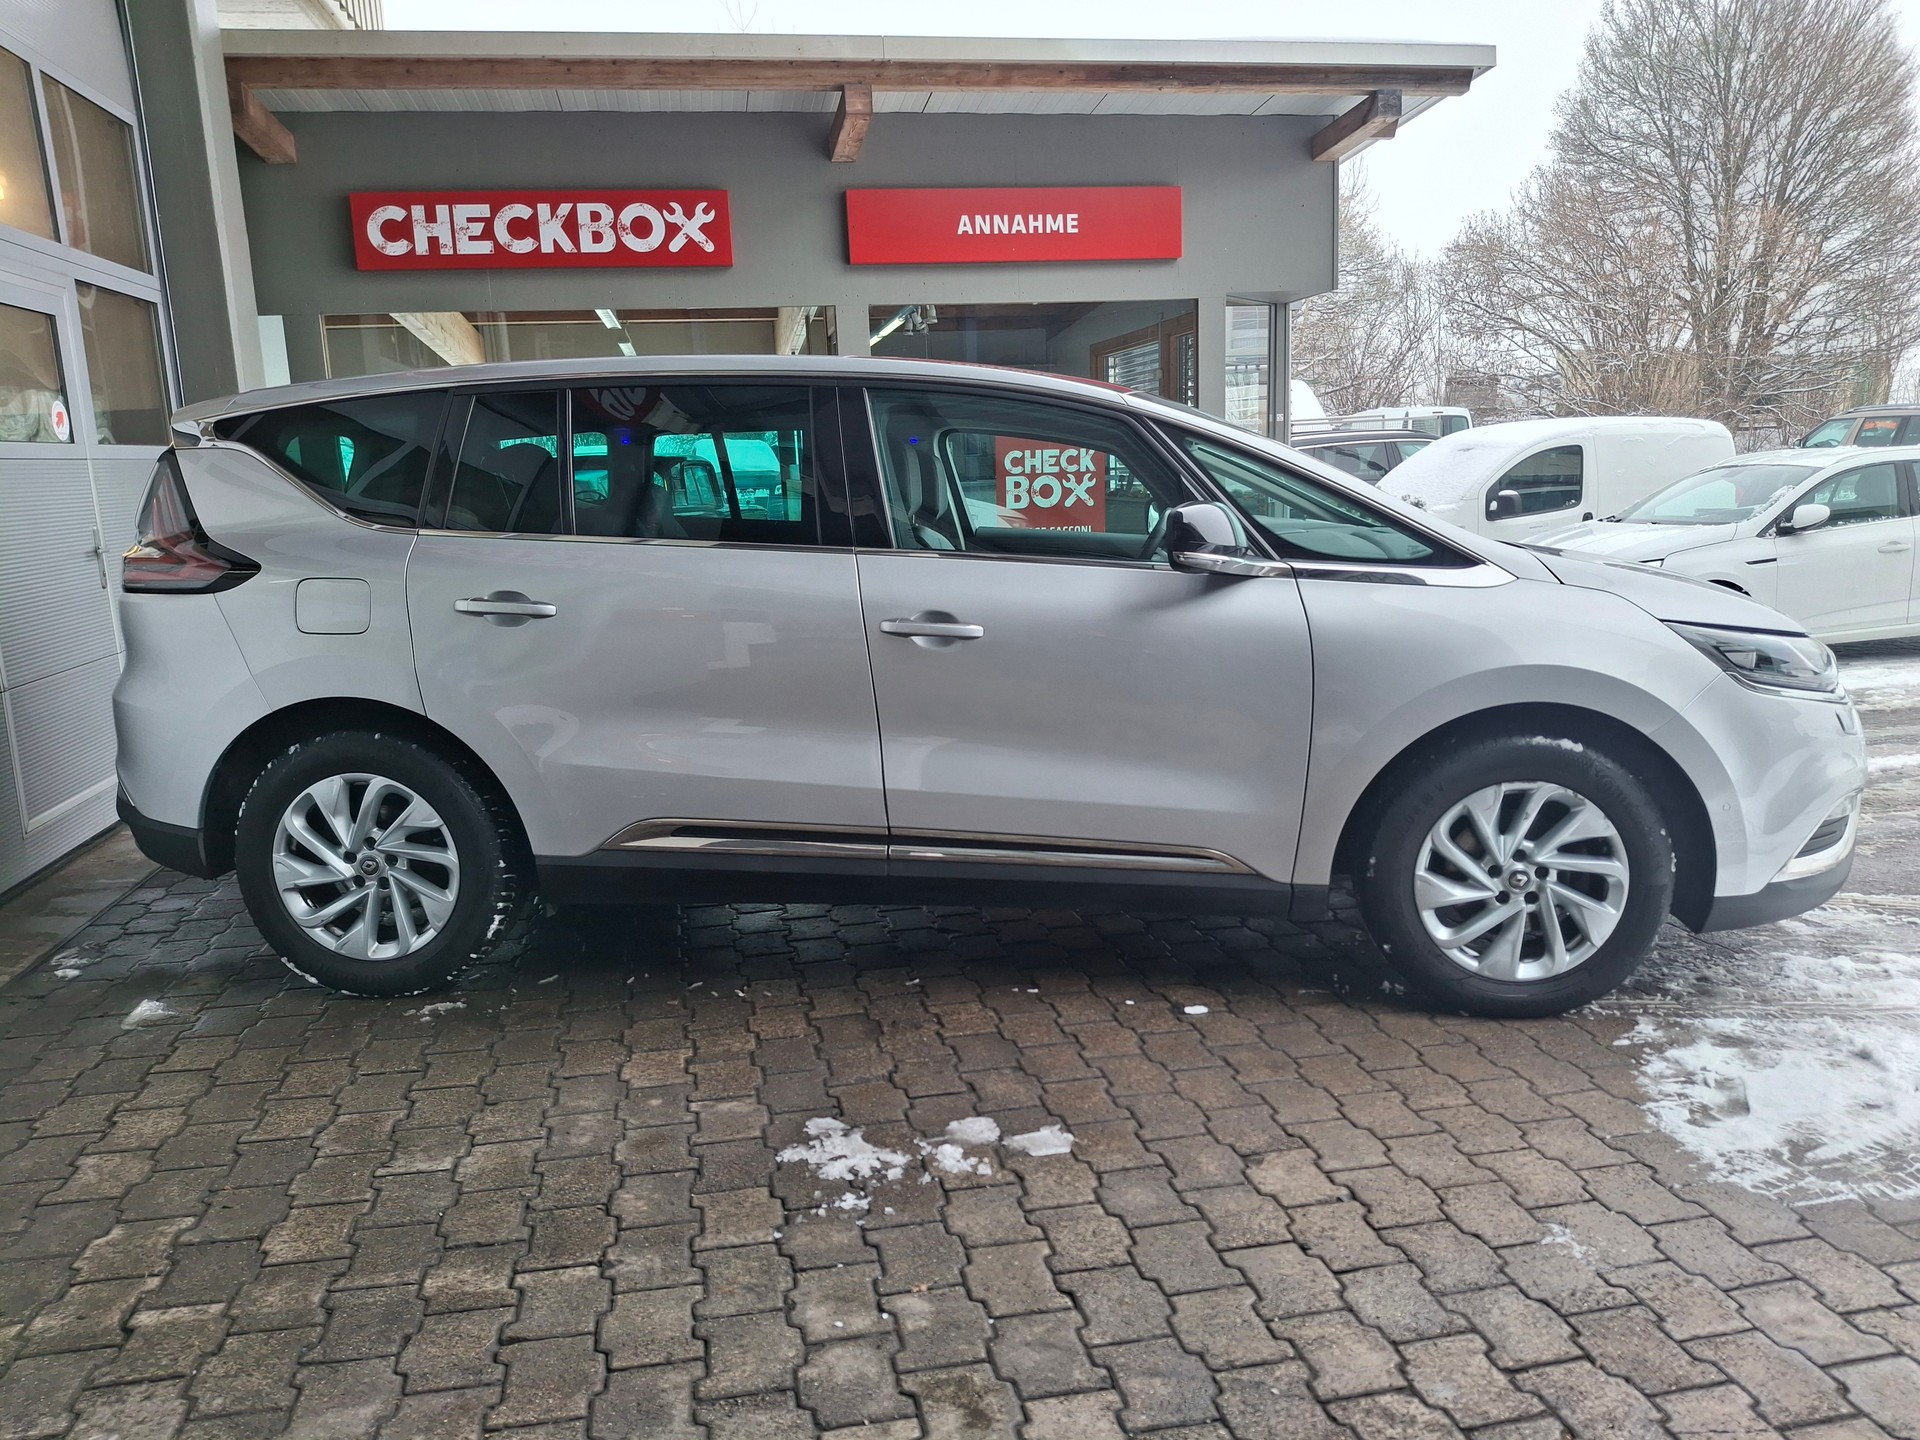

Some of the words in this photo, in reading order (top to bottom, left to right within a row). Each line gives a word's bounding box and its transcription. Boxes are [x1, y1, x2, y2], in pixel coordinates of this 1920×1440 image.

[366, 201, 716, 256] CHECKBOX
[956, 213, 1079, 235] ANNAHME
[1003, 448, 1097, 475] CHECK
[1005, 473, 1097, 510] BOX
